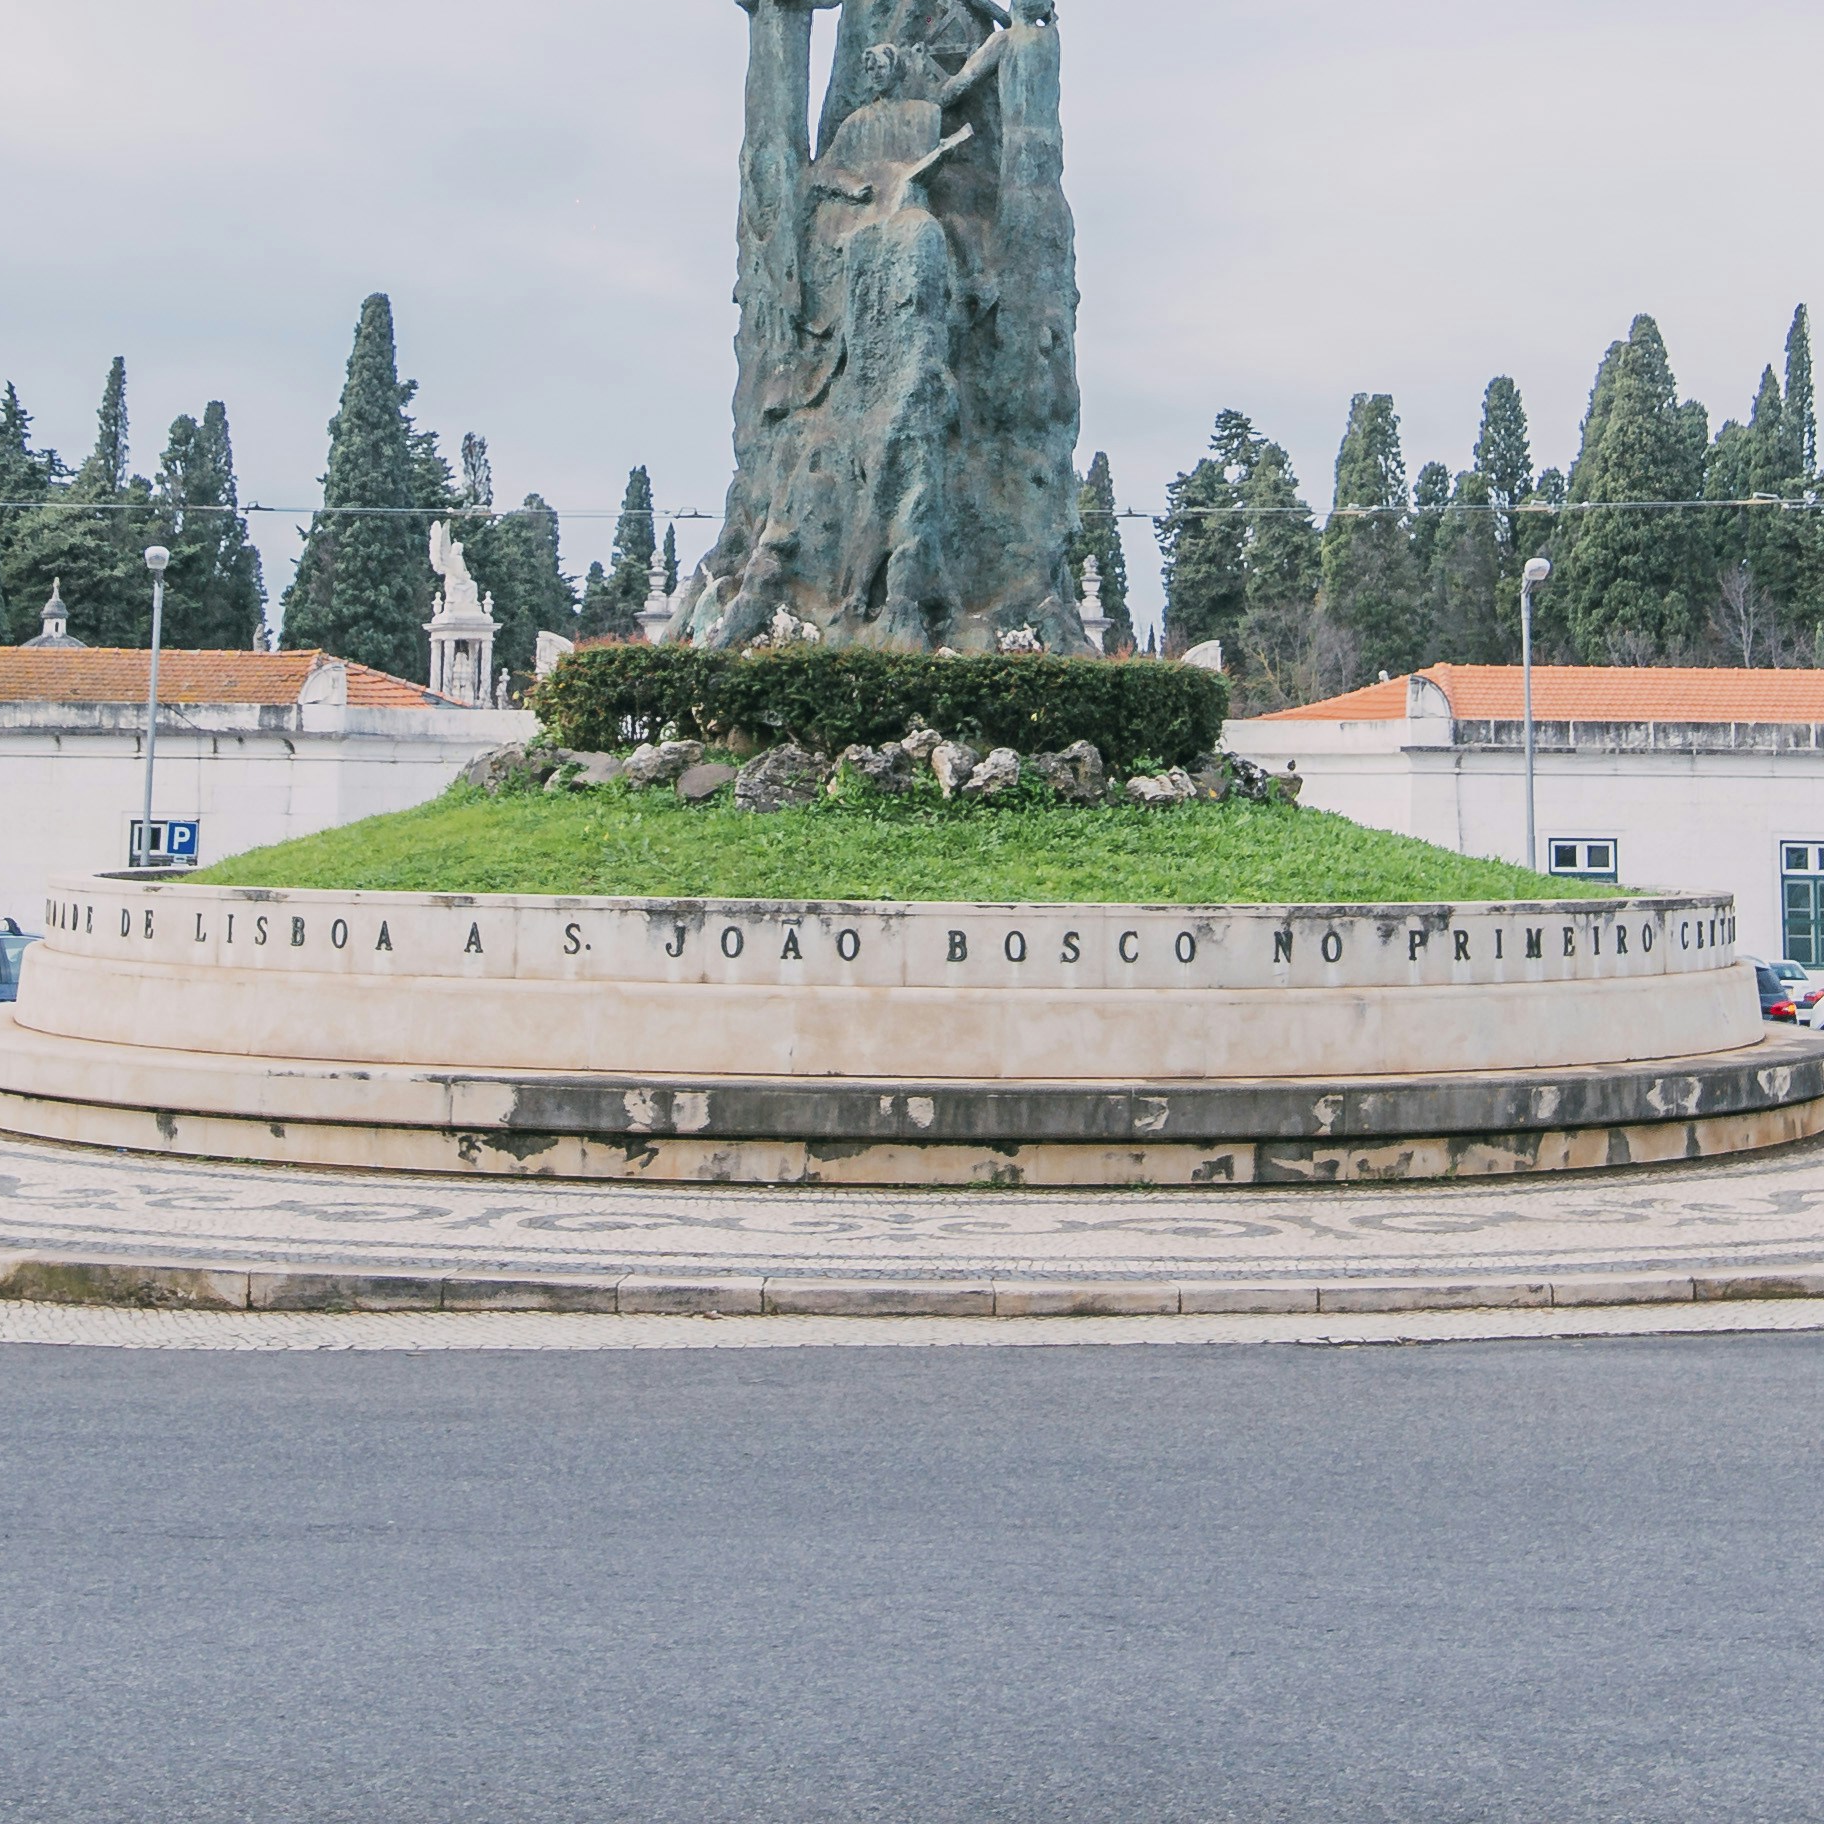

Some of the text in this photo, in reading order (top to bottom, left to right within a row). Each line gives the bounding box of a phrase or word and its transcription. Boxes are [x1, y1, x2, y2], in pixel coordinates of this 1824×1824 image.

[173, 826, 190, 850] P
[121, 908, 154, 939] DE
[194, 912, 394, 953] LISBOA
[463, 921, 484, 955] A
[563, 922, 592, 956] S.
[665, 915, 862, 962] JOÃO
[946, 930, 1198, 964] BOSCO
[1273, 930, 1343, 964] NO
[1408, 923, 1653, 963] PRIMEIRO
